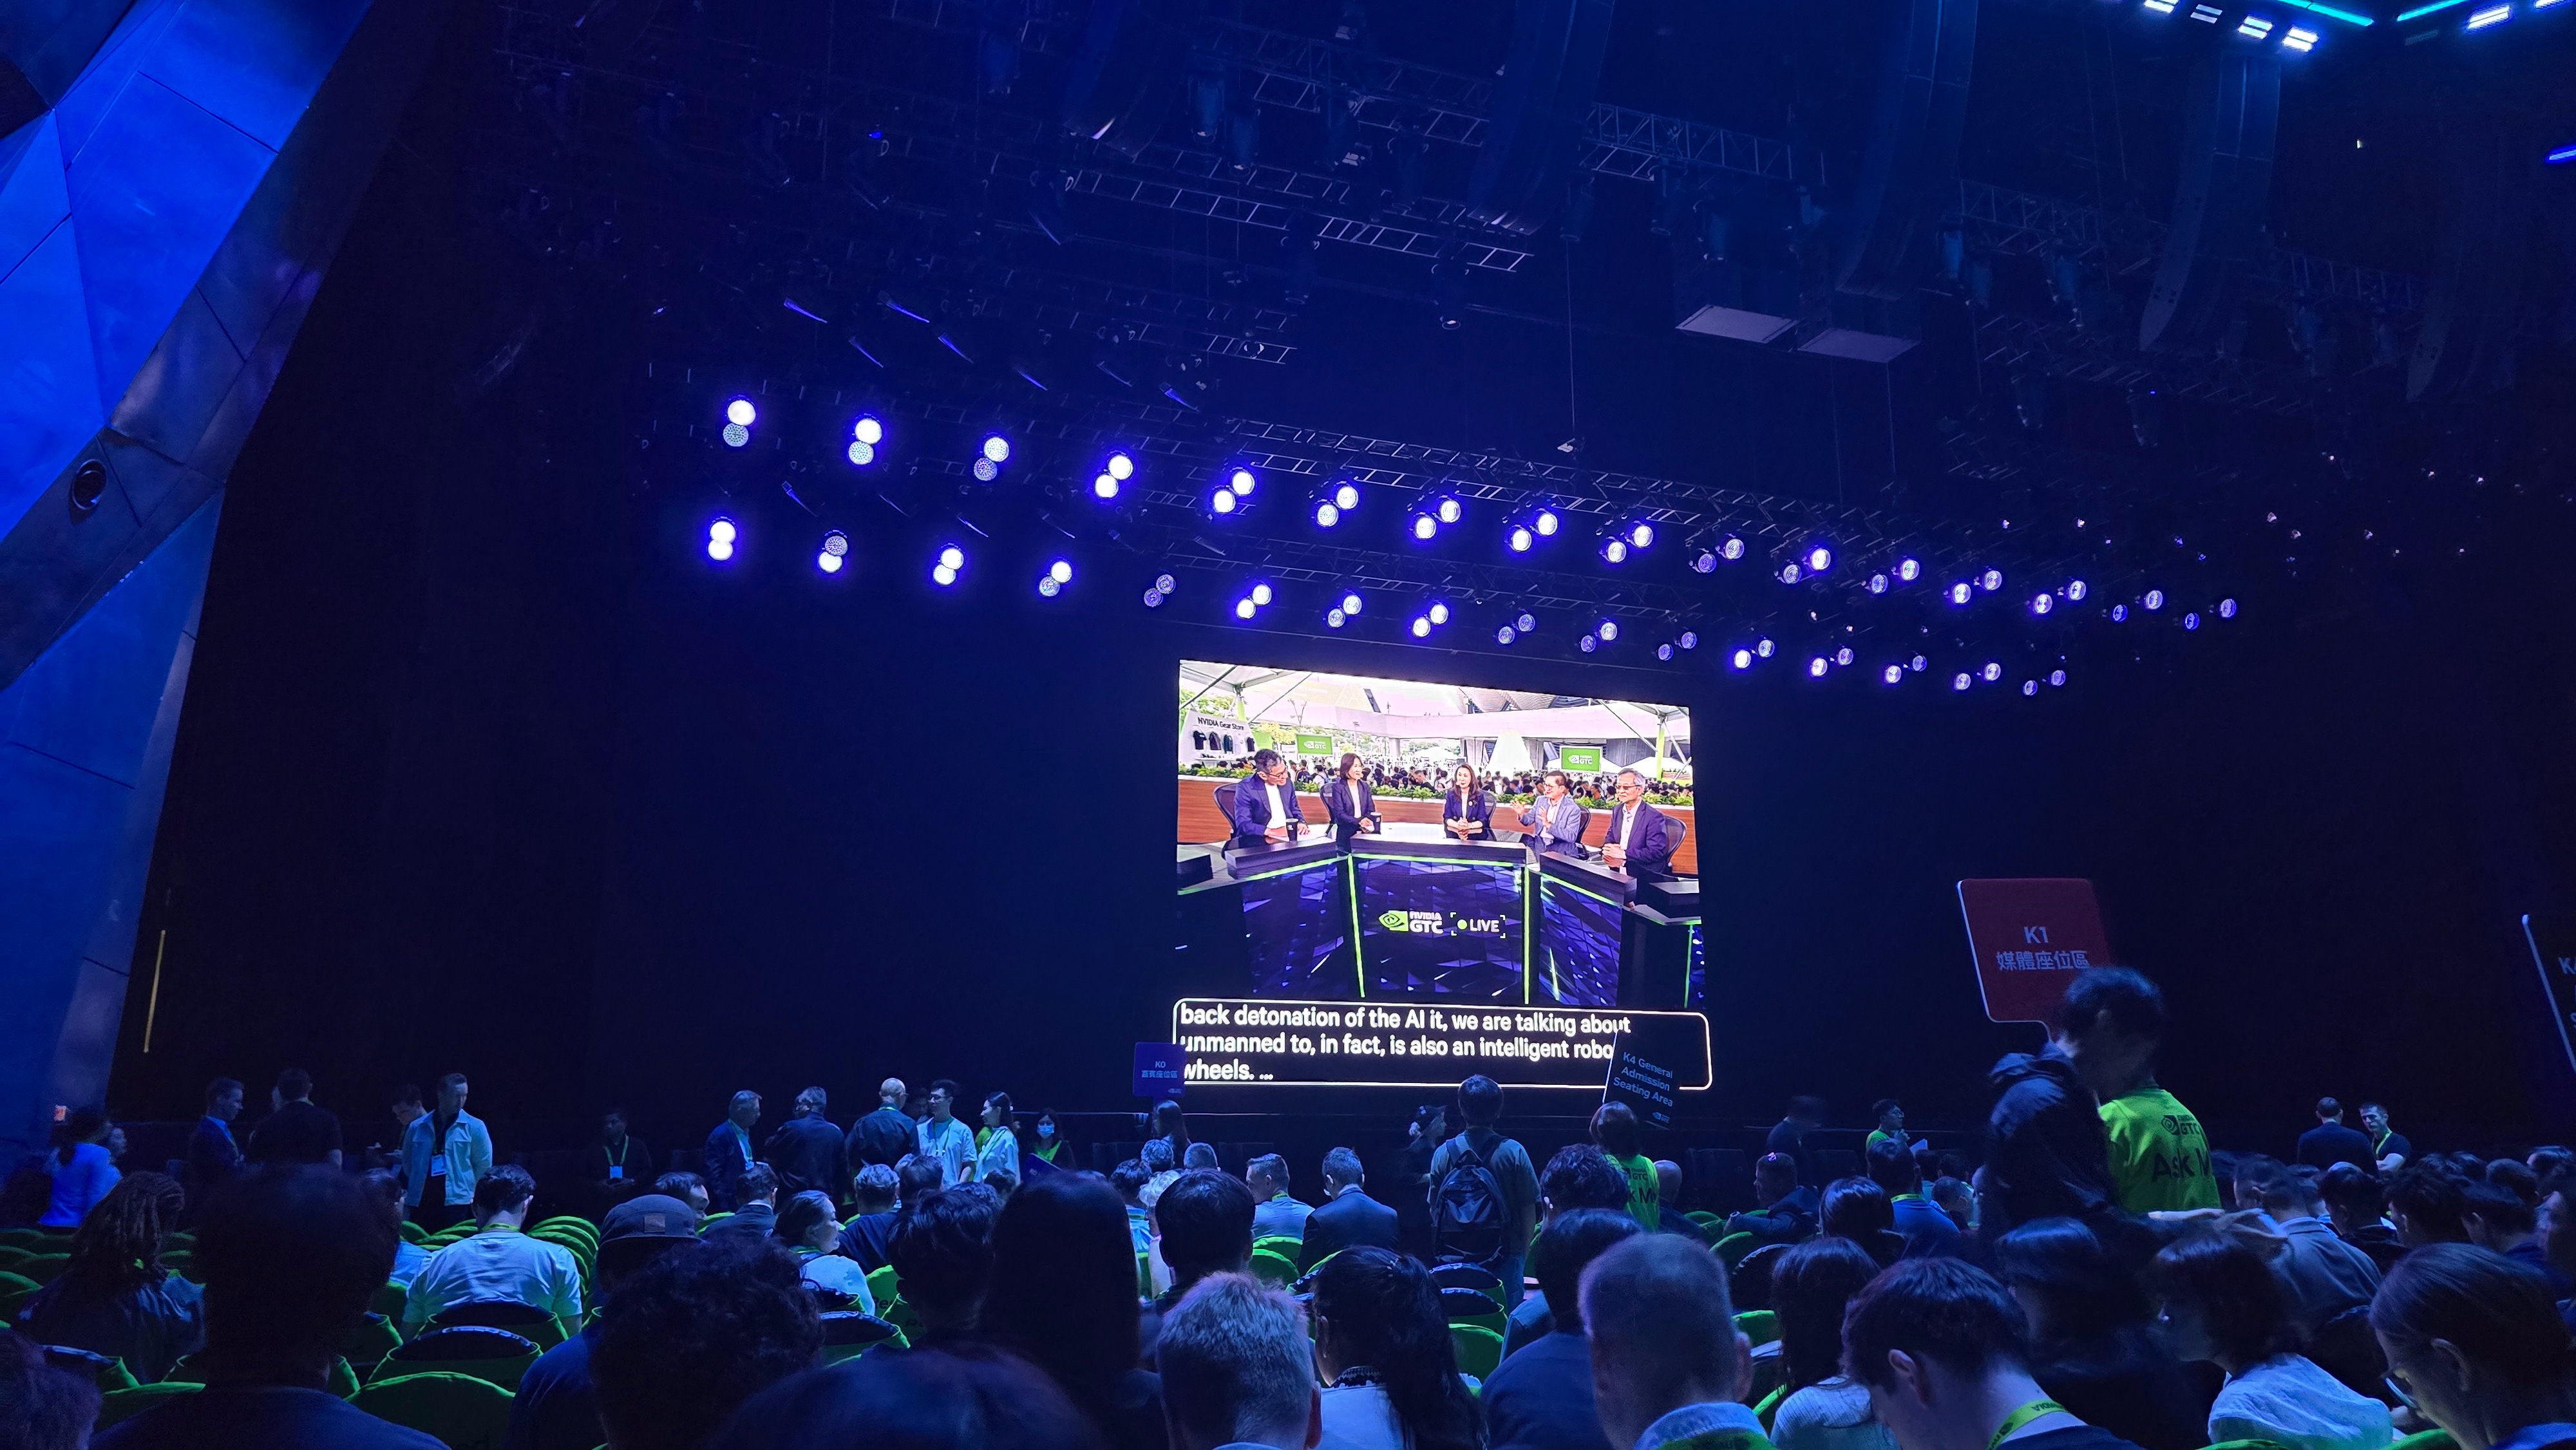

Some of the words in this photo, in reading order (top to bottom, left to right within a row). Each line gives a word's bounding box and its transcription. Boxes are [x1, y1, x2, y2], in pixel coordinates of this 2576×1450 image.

[1197, 717, 1219, 727] NVIDIA
[1409, 911, 1443, 921] NVIDIA
[1409, 920, 1444, 934] GTC
[1470, 919, 1499, 932] LIVE
[2023, 926, 2049, 943] K1
[1996, 950, 2090, 971] 媒體座位區
[2558, 957, 2576, 975] K
[1180, 1002, 1230, 1024] back
[1234, 1004, 1340, 1026] detonation
[1345, 1006, 1365, 1028] of
[1368, 1007, 1401, 1028] the
[1405, 1009, 1425, 1029] AI
[1430, 1009, 1448, 1031] it,
[1451, 1015, 1479, 1030] we
[1482, 1015, 1511, 1031] are
[1515, 1012, 1576, 1037] talking
[1580, 1013, 1631, 1033] about
[1180, 1031, 1285, 1053] unmanned
[1290, 1034, 1316, 1056] to,
[1320, 1033, 1338, 1053] in
[1342, 1033, 1385, 1057] fact,
[1390, 1035, 1406, 1055] is
[1410, 1035, 1448, 1055] also
[1452, 1040, 1475, 1056] an
[1479, 1037, 1569, 1062] intelligent
[1573, 1039, 1615, 1059] robo
[1184, 1059, 1255, 1080] wheels.
[1623, 1052, 1636, 1064] K4
[1638, 1058, 1673, 1079] General
[1621, 1066, 1670, 1091] Admission
[1613, 1077, 1651, 1099] Seating
[1652, 1091, 1673, 1107] Area
[2152, 1147, 2195, 1182] Ask
[2195, 1148, 2210, 1176] M
